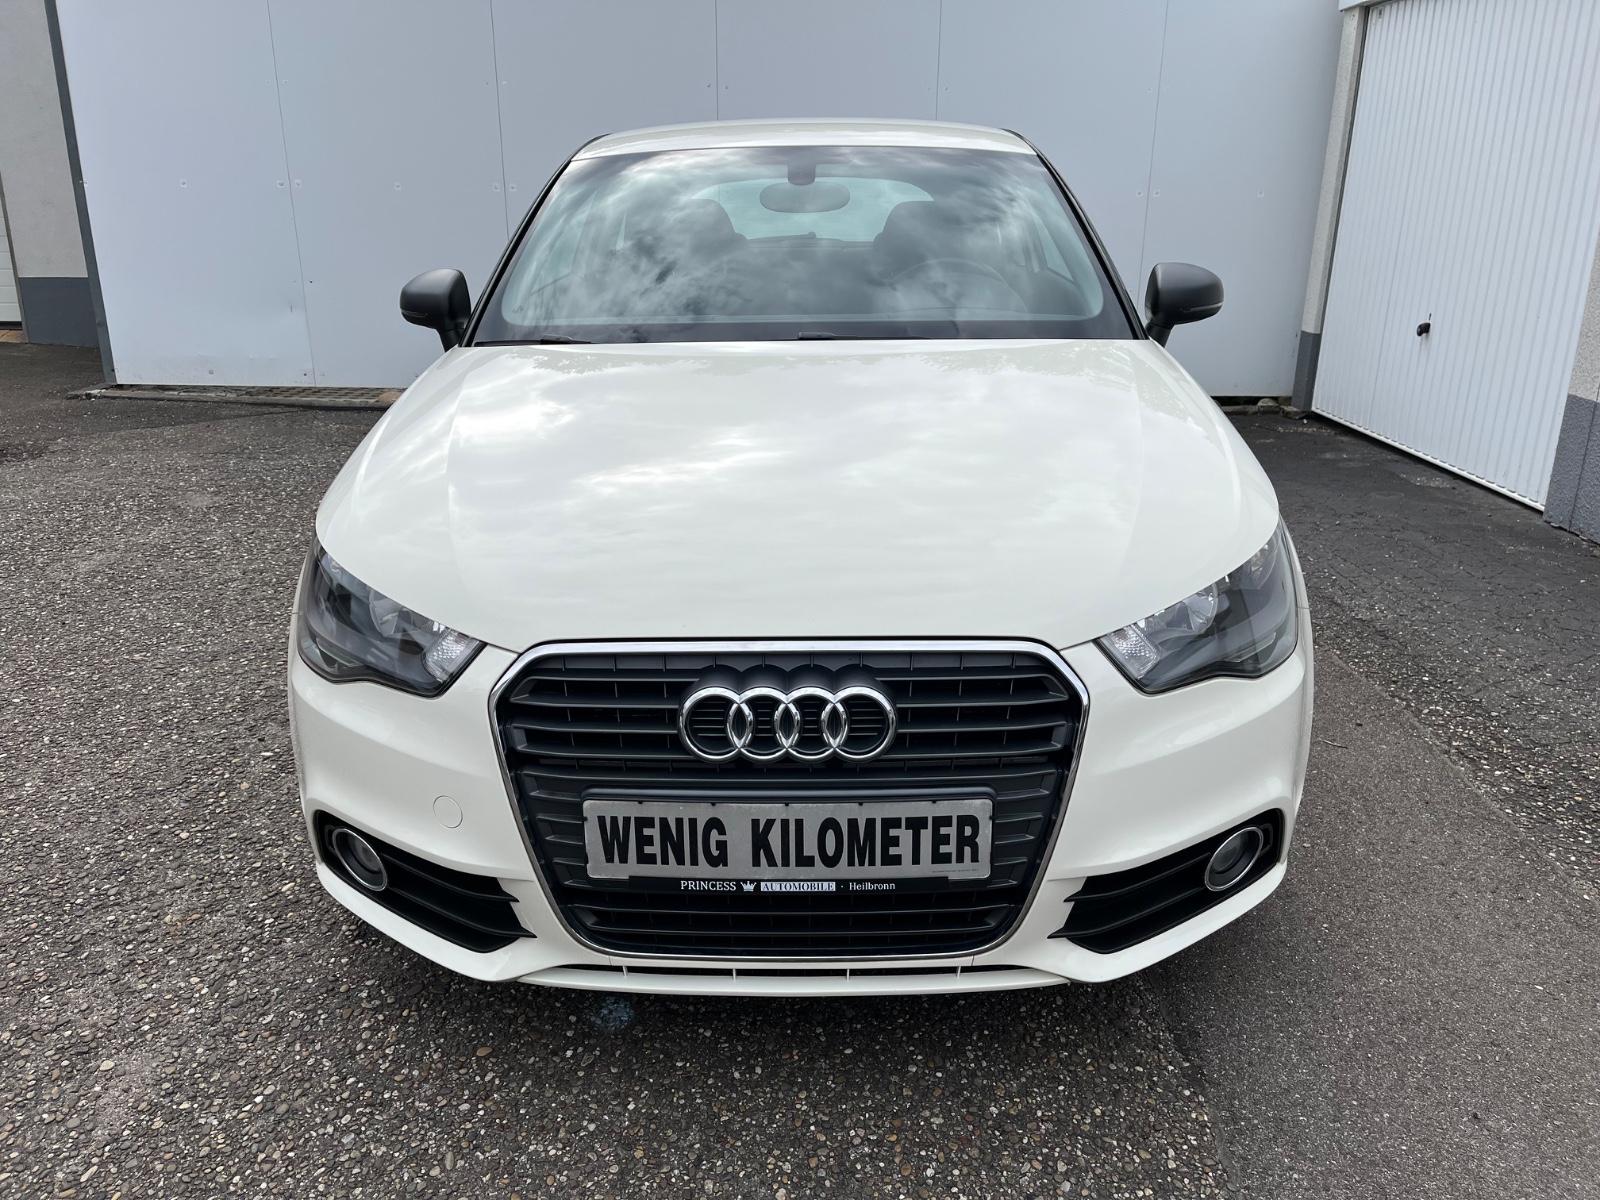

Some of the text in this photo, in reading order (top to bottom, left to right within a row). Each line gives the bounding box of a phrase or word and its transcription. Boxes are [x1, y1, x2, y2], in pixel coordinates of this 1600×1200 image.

[597, 815, 980, 868] WENIG KILOMETER
[680, 880, 896, 891] PRINCESS AUTOMOBILE Heilbronn
